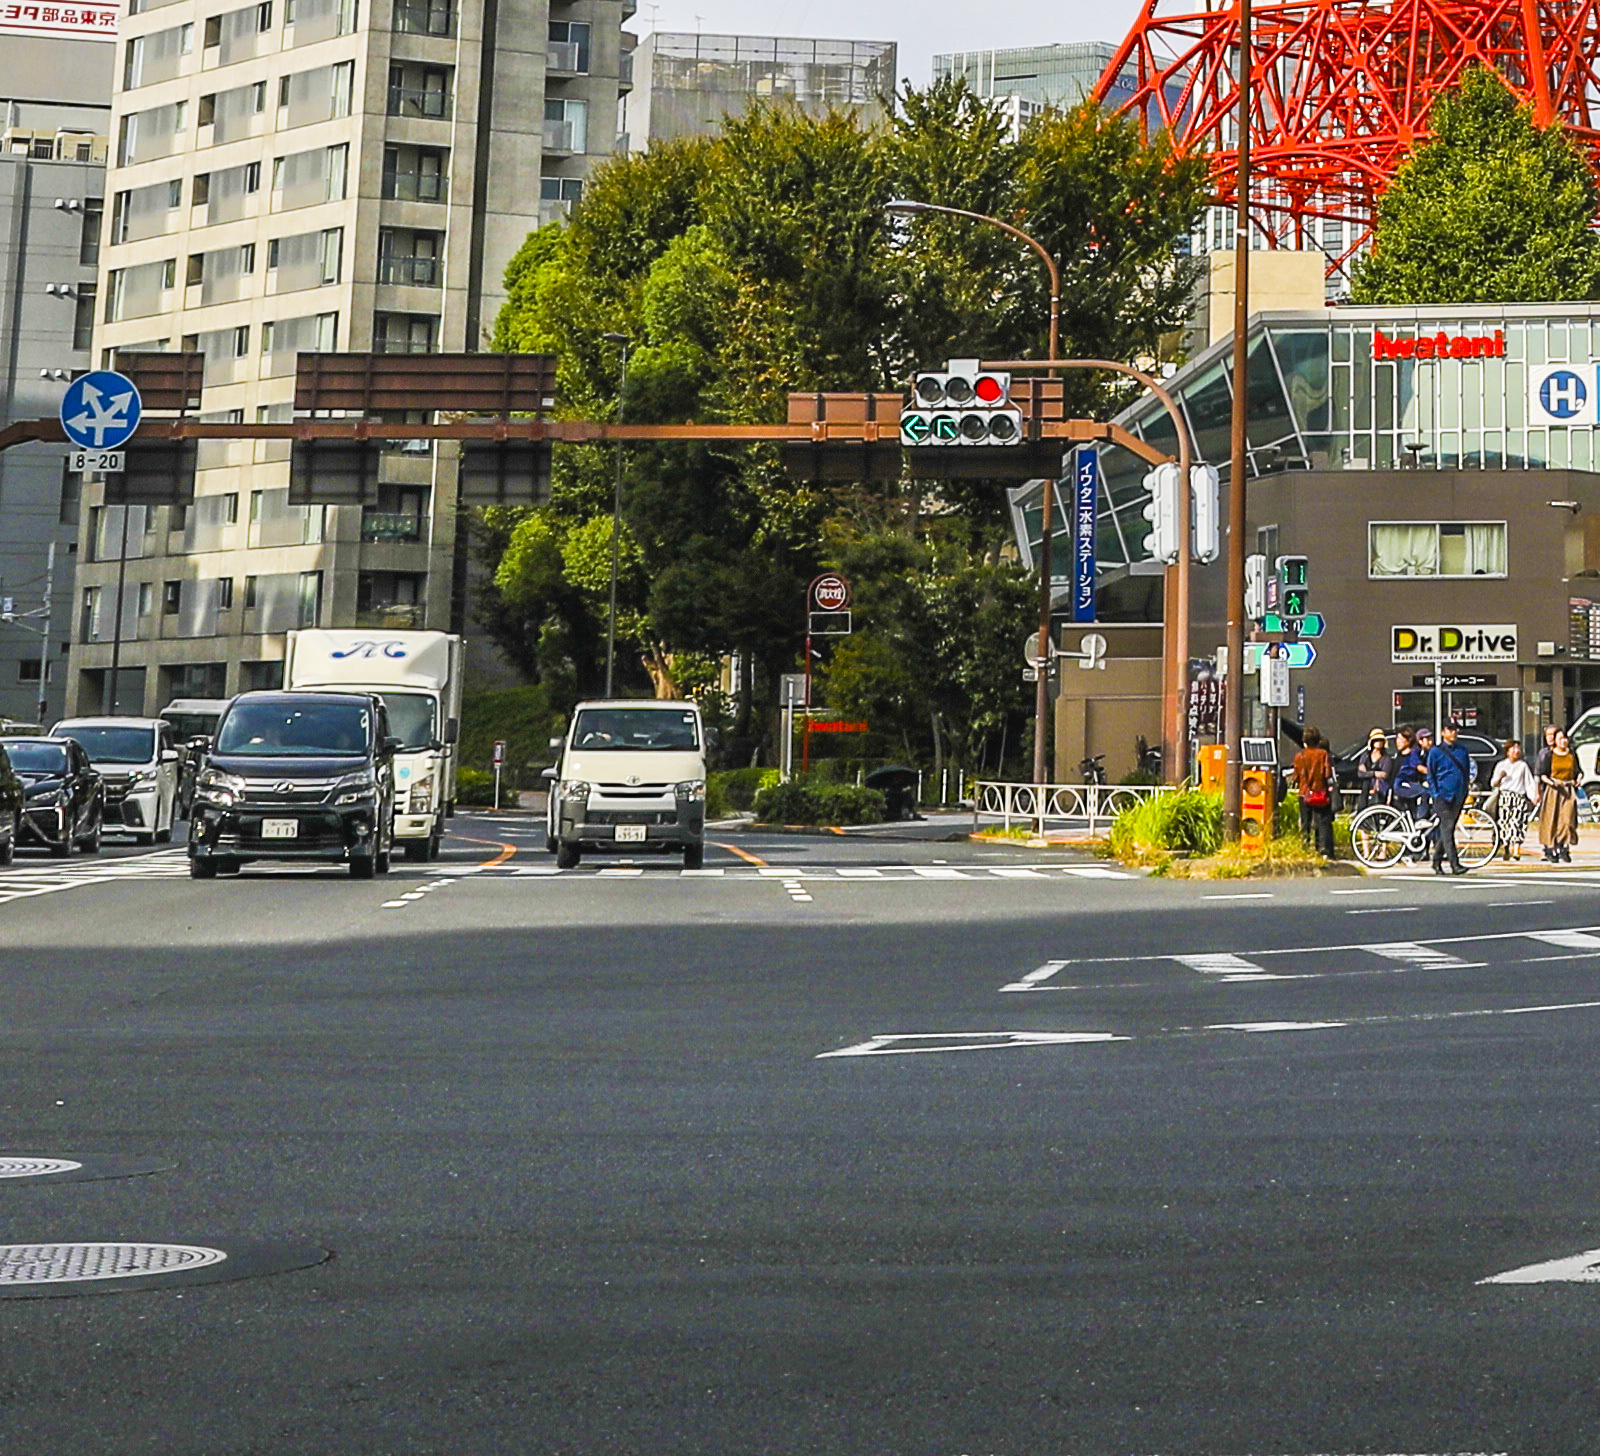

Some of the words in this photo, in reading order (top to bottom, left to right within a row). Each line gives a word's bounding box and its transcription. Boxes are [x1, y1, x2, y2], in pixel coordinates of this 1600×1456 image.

[1373, 329, 1505, 359] Iwatani
[76, 454, 119, 469] 8-20
[1079, 461, 1093, 609] イワタニ水素ステーション
[1393, 627, 1433, 653] Dr.
[1438, 627, 1516, 653] Drive
